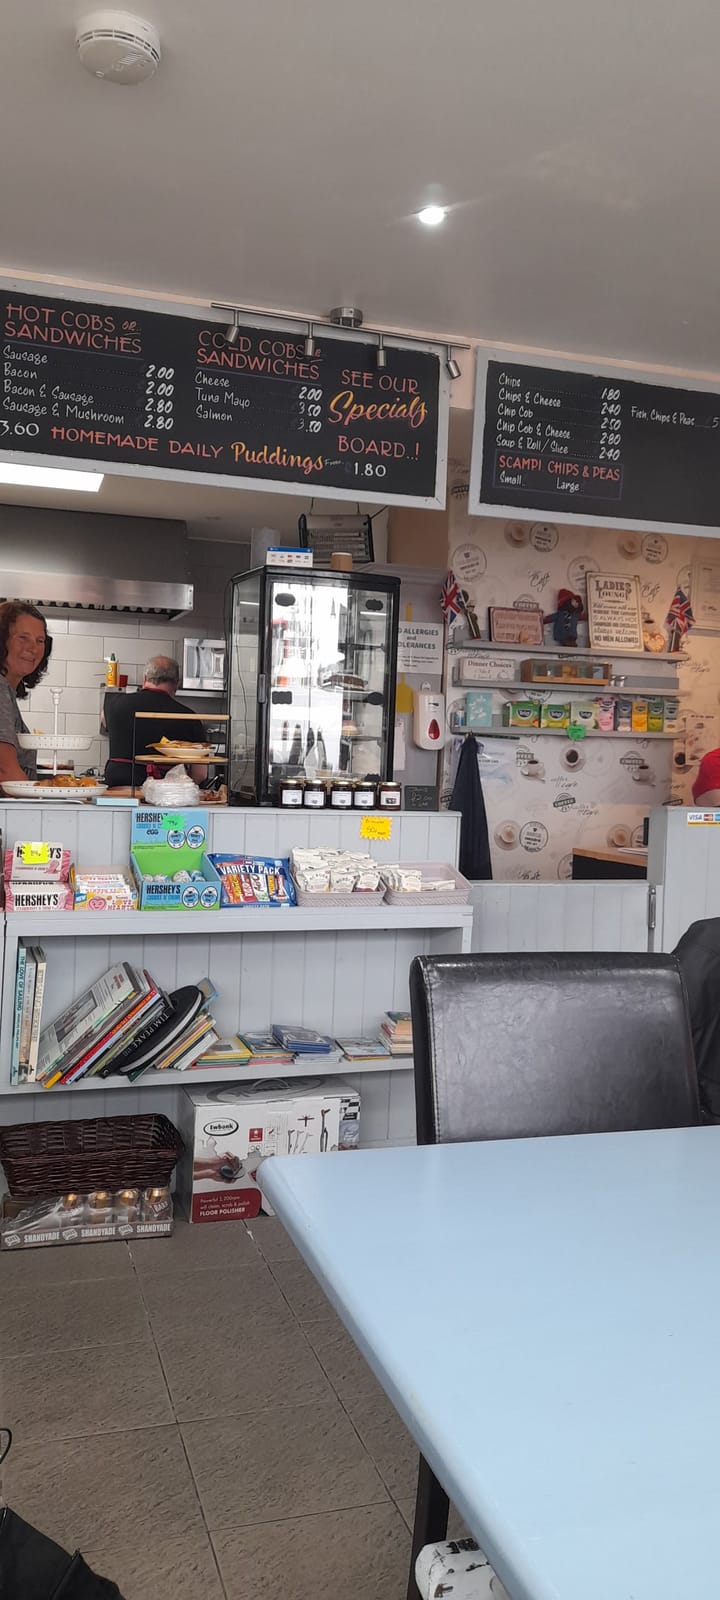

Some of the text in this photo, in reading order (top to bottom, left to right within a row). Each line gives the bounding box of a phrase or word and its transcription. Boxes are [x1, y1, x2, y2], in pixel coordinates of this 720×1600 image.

[6, 303, 55, 324] HOT
[61, 310, 115, 332] COBS
[4, 321, 142, 354] SANDWICHES
[3, 344, 48, 365] Sausage
[3, 362, 38, 379] Bacon
[145, 364, 175, 380] 2.00
[196, 348, 320, 380] SANDWICHES
[195, 371, 230, 388] Cheese
[341, 369, 419, 396] SEE OUR
[498, 373, 521, 388] Chips
[3, 379, 95, 406] Bacon & Sausage
[145, 381, 174, 397] 2.00
[195, 387, 250, 408] Tuna Mayo
[298, 386, 323, 401] 2.00
[145, 397, 173, 414] 2.80
[498, 388, 561, 408] Chips & Cheese
[2, 397, 125, 424] Sausage & Mushroom
[195, 404, 233, 422] Salmon
[328, 390, 428, 428] Specials
[497, 403, 534, 419] Chip Cob
[650, 409, 671, 424] Chips
[672, 412, 678, 424] &
[679, 412, 696, 426] Peas
[0, 420, 40, 437] 3.60
[144, 414, 174, 431] 2.80
[496, 419, 571, 440] Chip Cob & Cheese
[51, 426, 159, 452] HOMEMADE
[169, 440, 223, 459] DAILY
[231, 441, 324, 475] Puddings
[354, 461, 387, 477] 1.80
[496, 434, 516, 449] Soup
[518, 436, 524, 449] &
[550, 440, 569, 455] Slice
[498, 455, 620, 481] SCAMPI CHIPS & PEAS
[595, 580, 632, 594] LADIES
[403, 627, 439, 636] ALLERGIES
[220, 864, 281, 875] VARIETY PACK
[146, 884, 181, 895] HERSHEY'S
[15, 893, 59, 907] HERSHEY'S
[18, 967, 26, 981] LOVE
[18, 981, 25, 989] OF
[16, 989, 24, 1011] SAILING
[132, 1012, 171, 1047] TIM PEAKE
[210, 1122, 234, 1130] Ewbank
[219, 1207, 246, 1215] POLISHER
[81, 1227, 116, 1238] SHANDYADE
[136, 1223, 171, 1233] SHANDYADE
[24, 1231, 60, 1243] SHANDYADE
